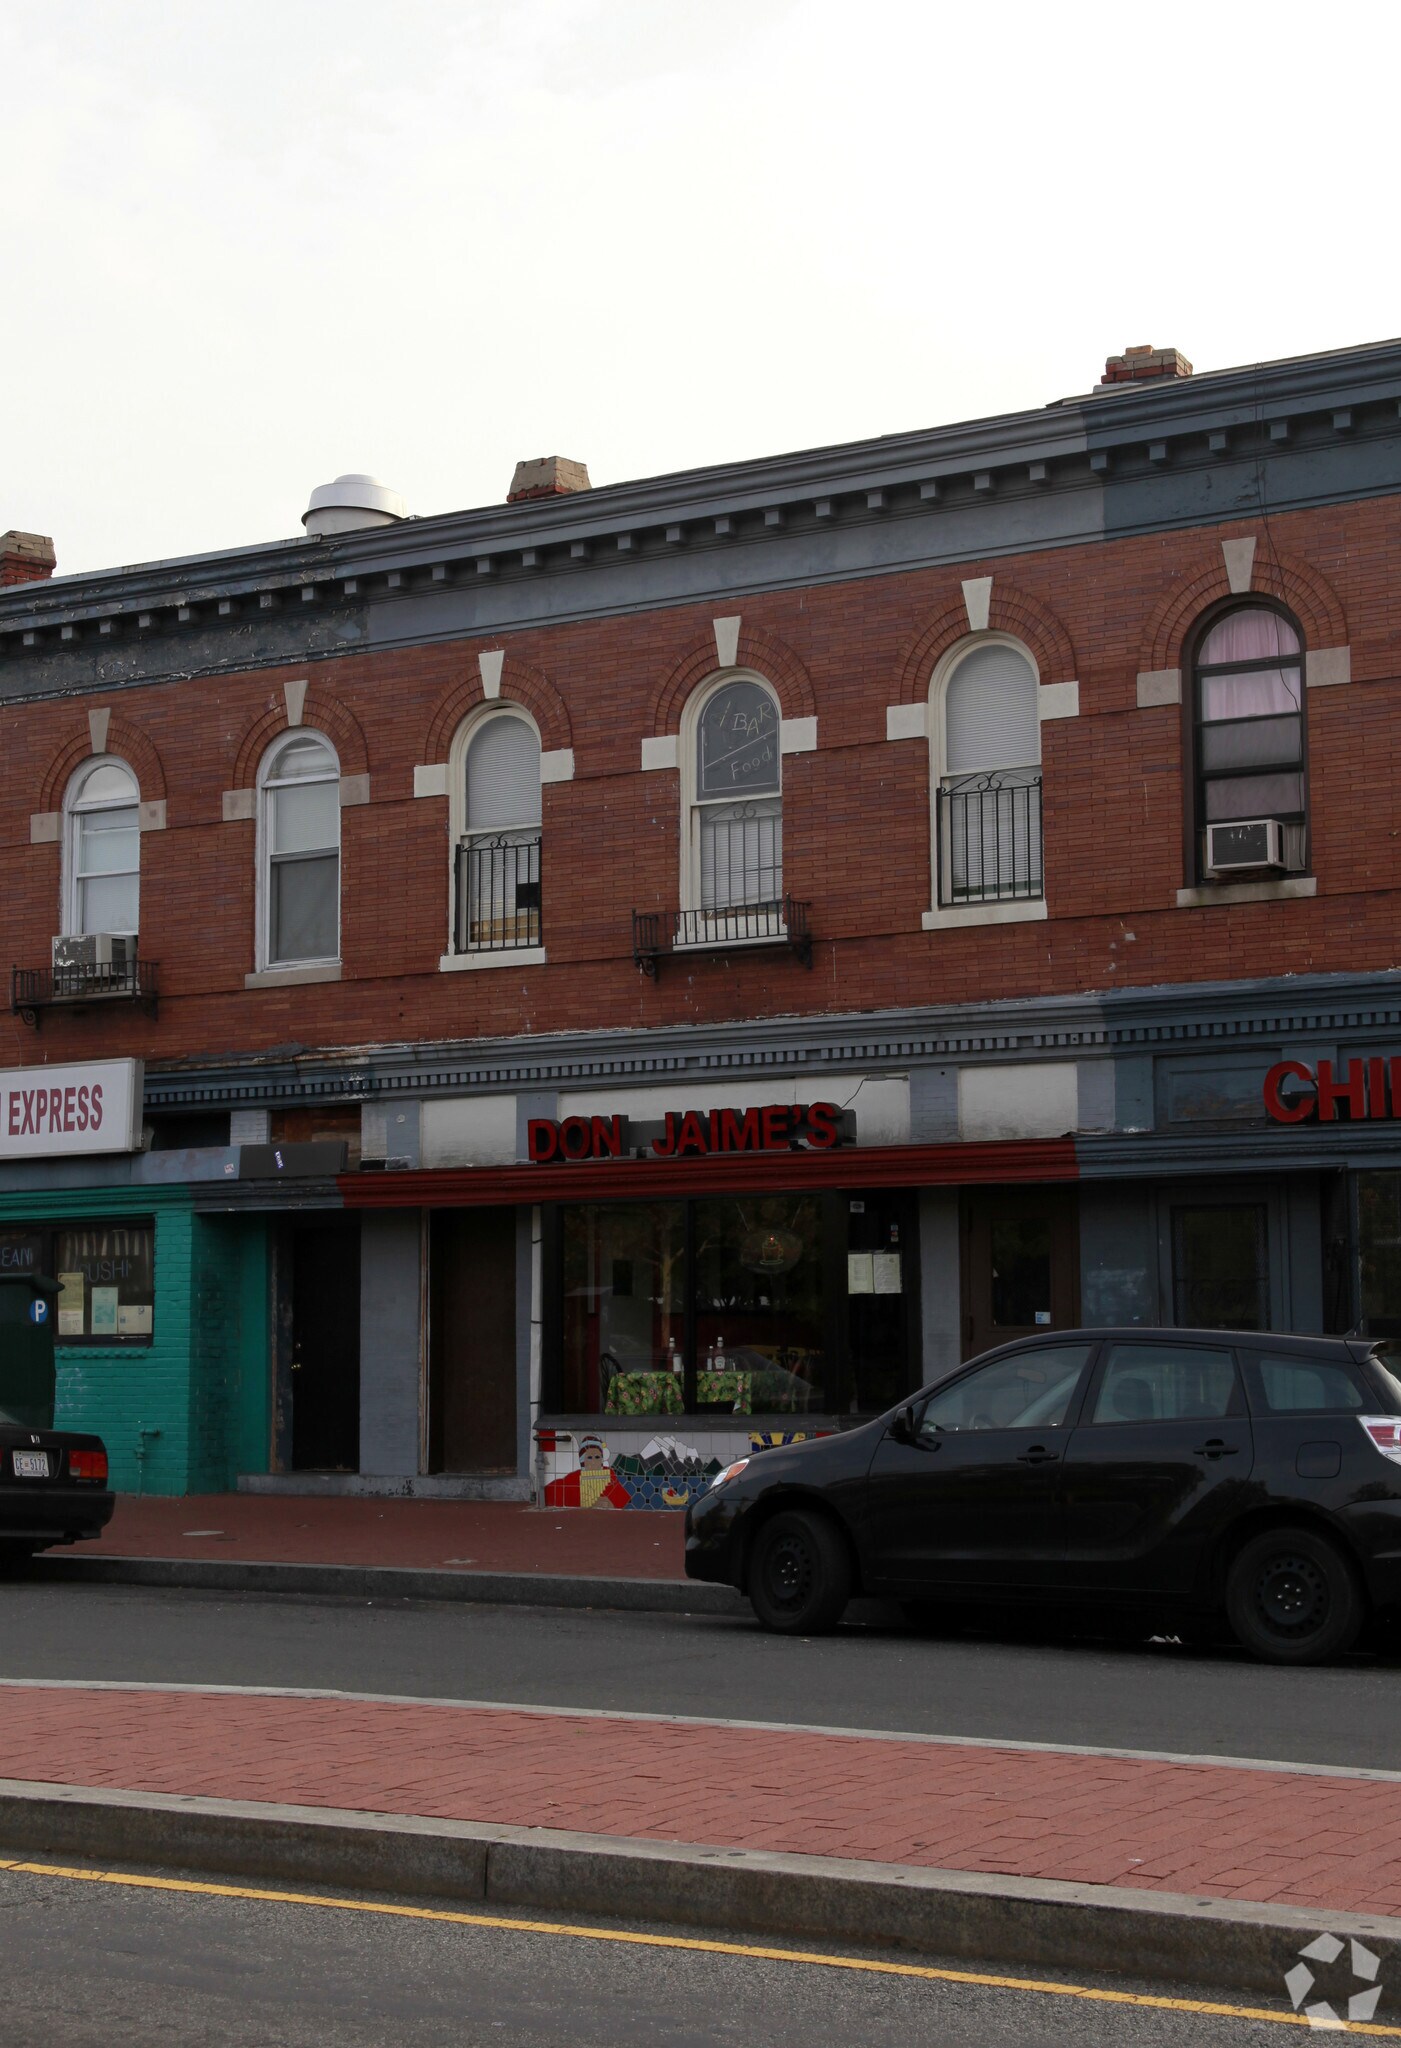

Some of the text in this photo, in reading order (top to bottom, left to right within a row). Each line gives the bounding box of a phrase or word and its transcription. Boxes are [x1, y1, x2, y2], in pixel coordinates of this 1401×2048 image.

[731, 702, 773, 737] BAR
[730, 746, 773, 780] Food
[8, 1084, 103, 1136] EXPRESS
[527, 1102, 839, 1162] DON JAIME'S
[0, 1246, 31, 1267] EAN
[35, 1300, 46, 1322] P
